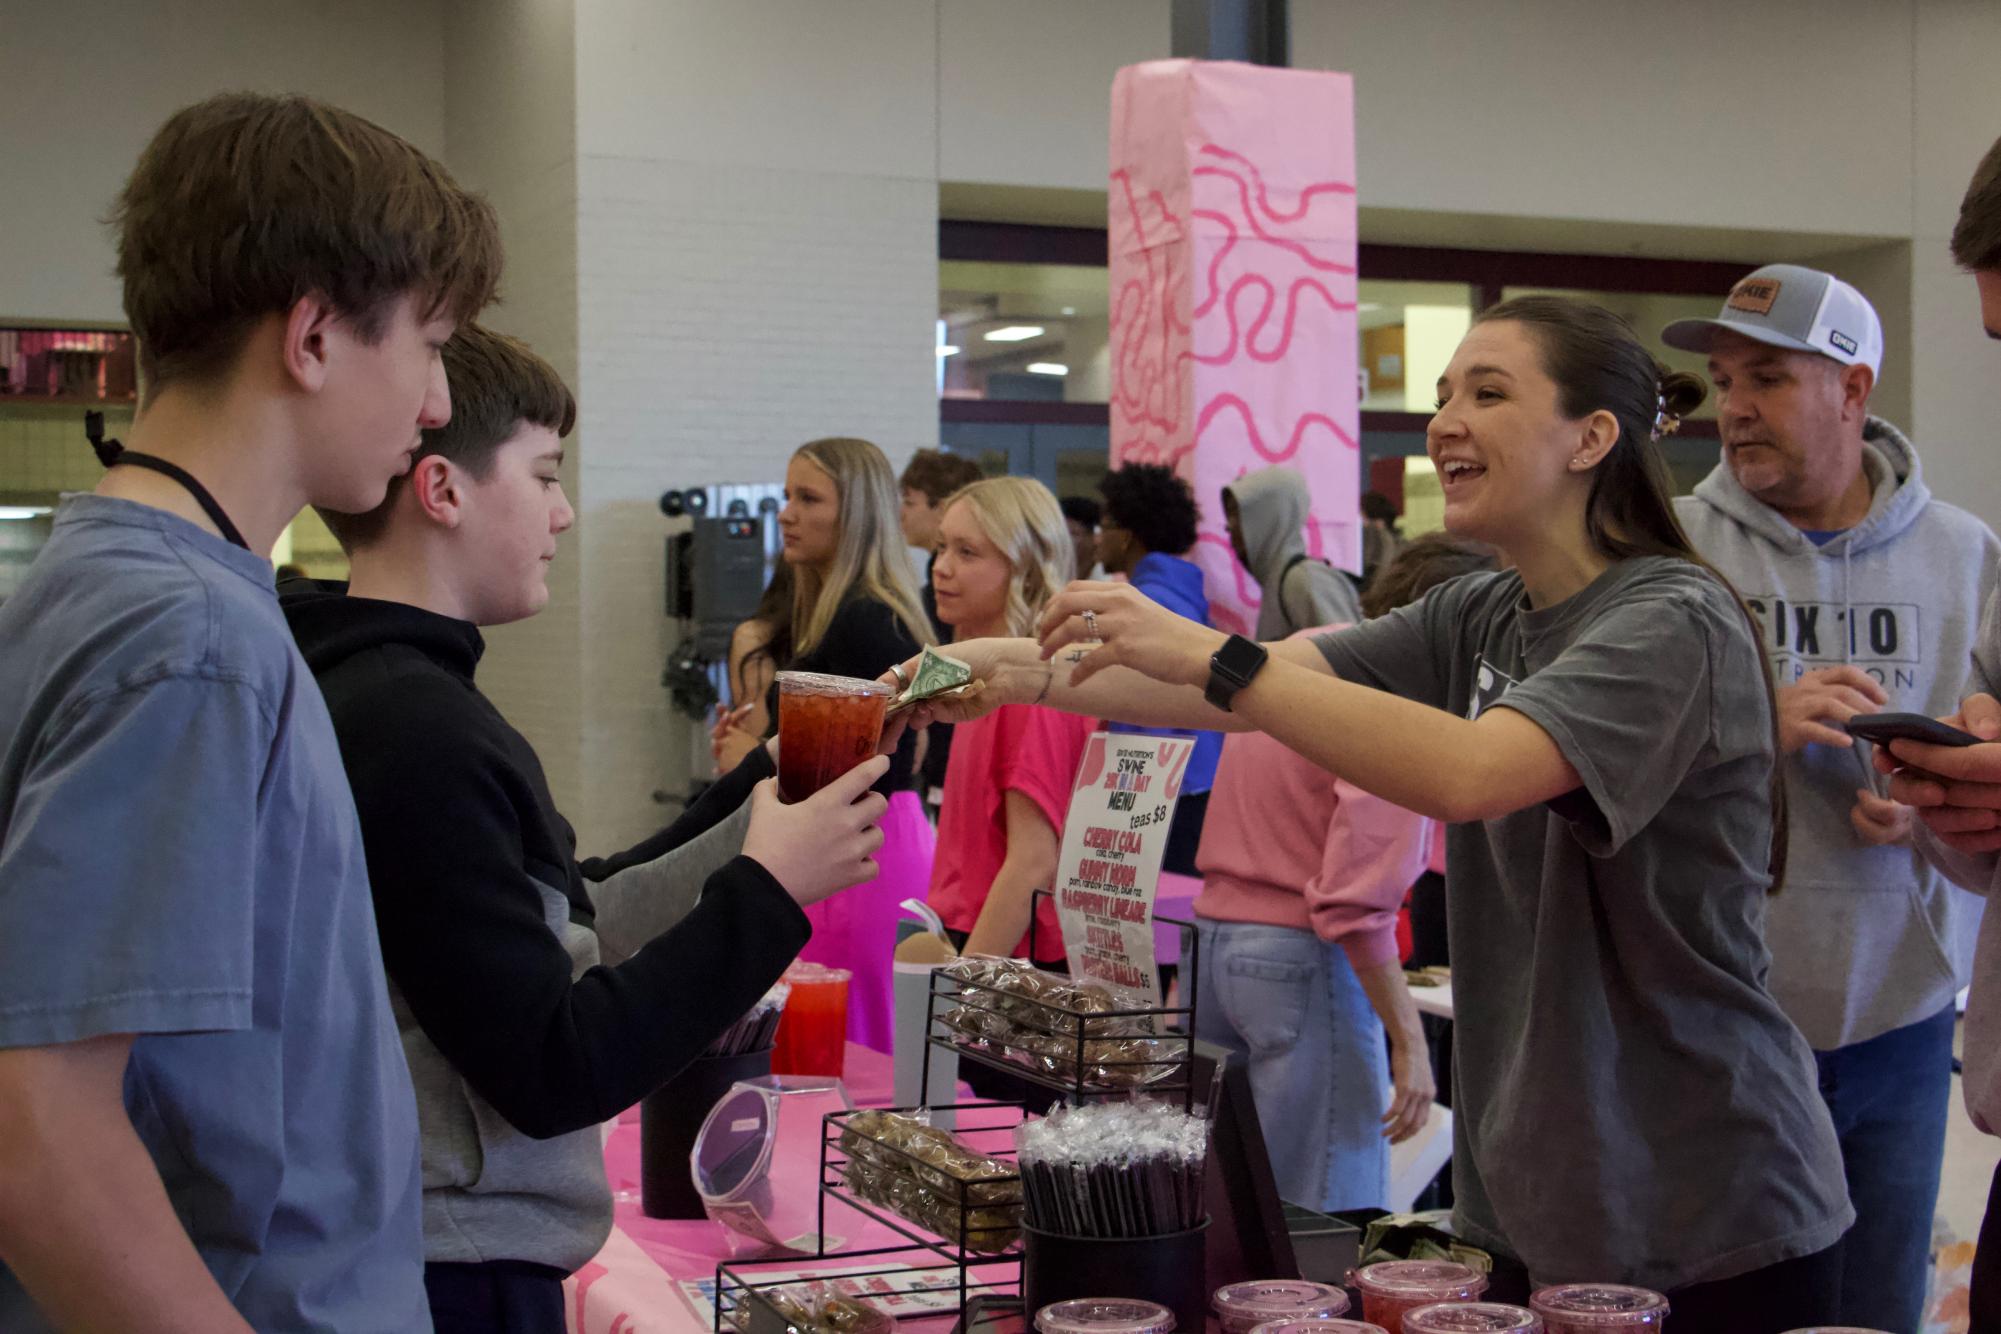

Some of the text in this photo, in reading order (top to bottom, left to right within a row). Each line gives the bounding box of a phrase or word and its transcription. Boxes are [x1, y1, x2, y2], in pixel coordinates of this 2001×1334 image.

[1118, 759, 1145, 774] SWINE
[1108, 791, 1136, 811] MENU
[1130, 805, 1166, 829] teas $8
[1083, 826, 1143, 854] CHERRY COLA
[1108, 850, 1125, 862] cherry
[1062, 887, 1147, 924] RASPBERRY LIMEADE
[1112, 962, 1141, 989] BALLS
